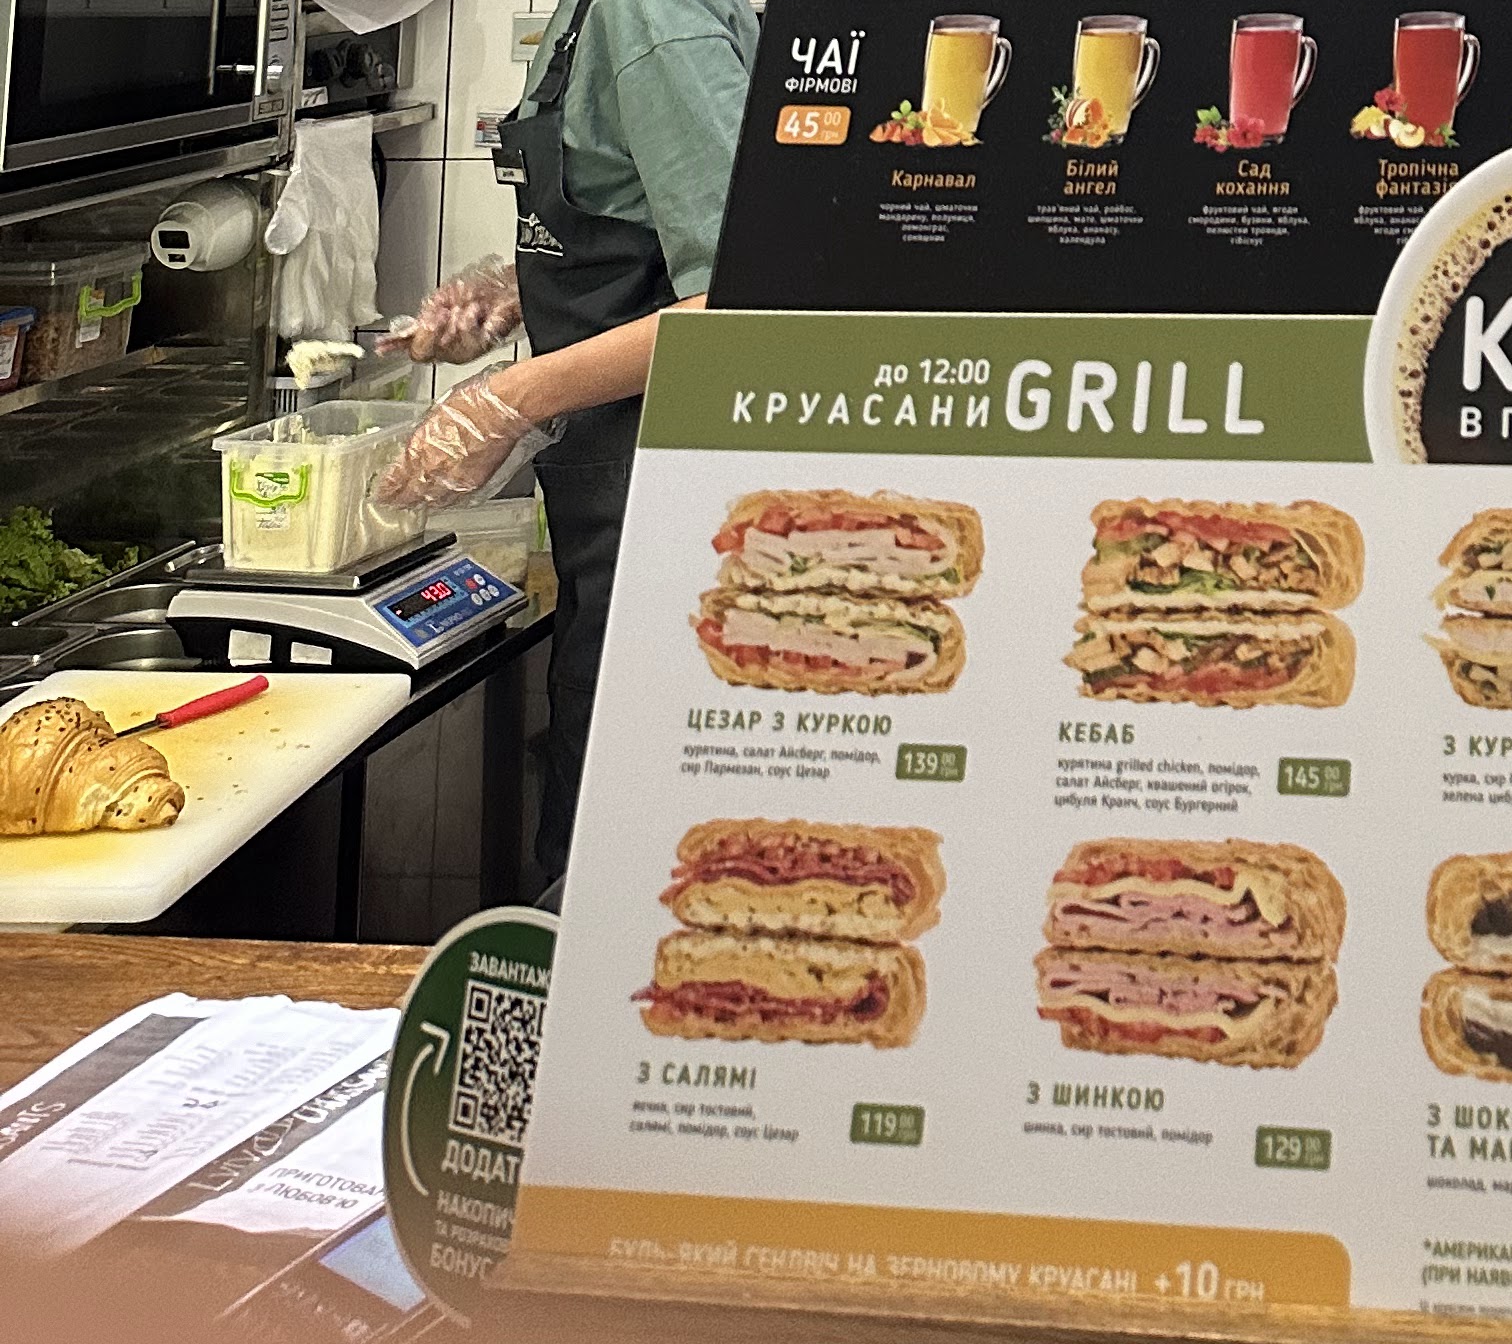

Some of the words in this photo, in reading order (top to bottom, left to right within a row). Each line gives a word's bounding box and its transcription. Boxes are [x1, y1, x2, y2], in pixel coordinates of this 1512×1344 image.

[791, 30, 866, 76] ЧАЇ
[784, 76, 858, 94] ФІРМОВІ
[891, 169, 976, 191] Карнавал
[1066, 159, 1119, 177] Білий
[1237, 159, 1272, 180] Сад
[1378, 158, 1459, 182] Тропічна
[1063, 180, 1117, 195] ангел
[1215, 181, 1290, 196] кохання
[873, 364, 909, 388] до
[919, 358, 991, 385] 12:00
[732, 390, 990, 428] КРУАСАНИ
[1005, 359, 1265, 435] GRILL
[1459, 406, 1482, 438] в
[687, 708, 762, 733] ЦЕЗАР
[796, 712, 892, 736] КУРКОЮ
[1058, 721, 1135, 745] КЕБАБ
[661, 1061, 757, 1090] САЛЯМІ
[1052, 1083, 1165, 1113] ШИНКОЮ
[1426, 1133, 1456, 1158] ТА
